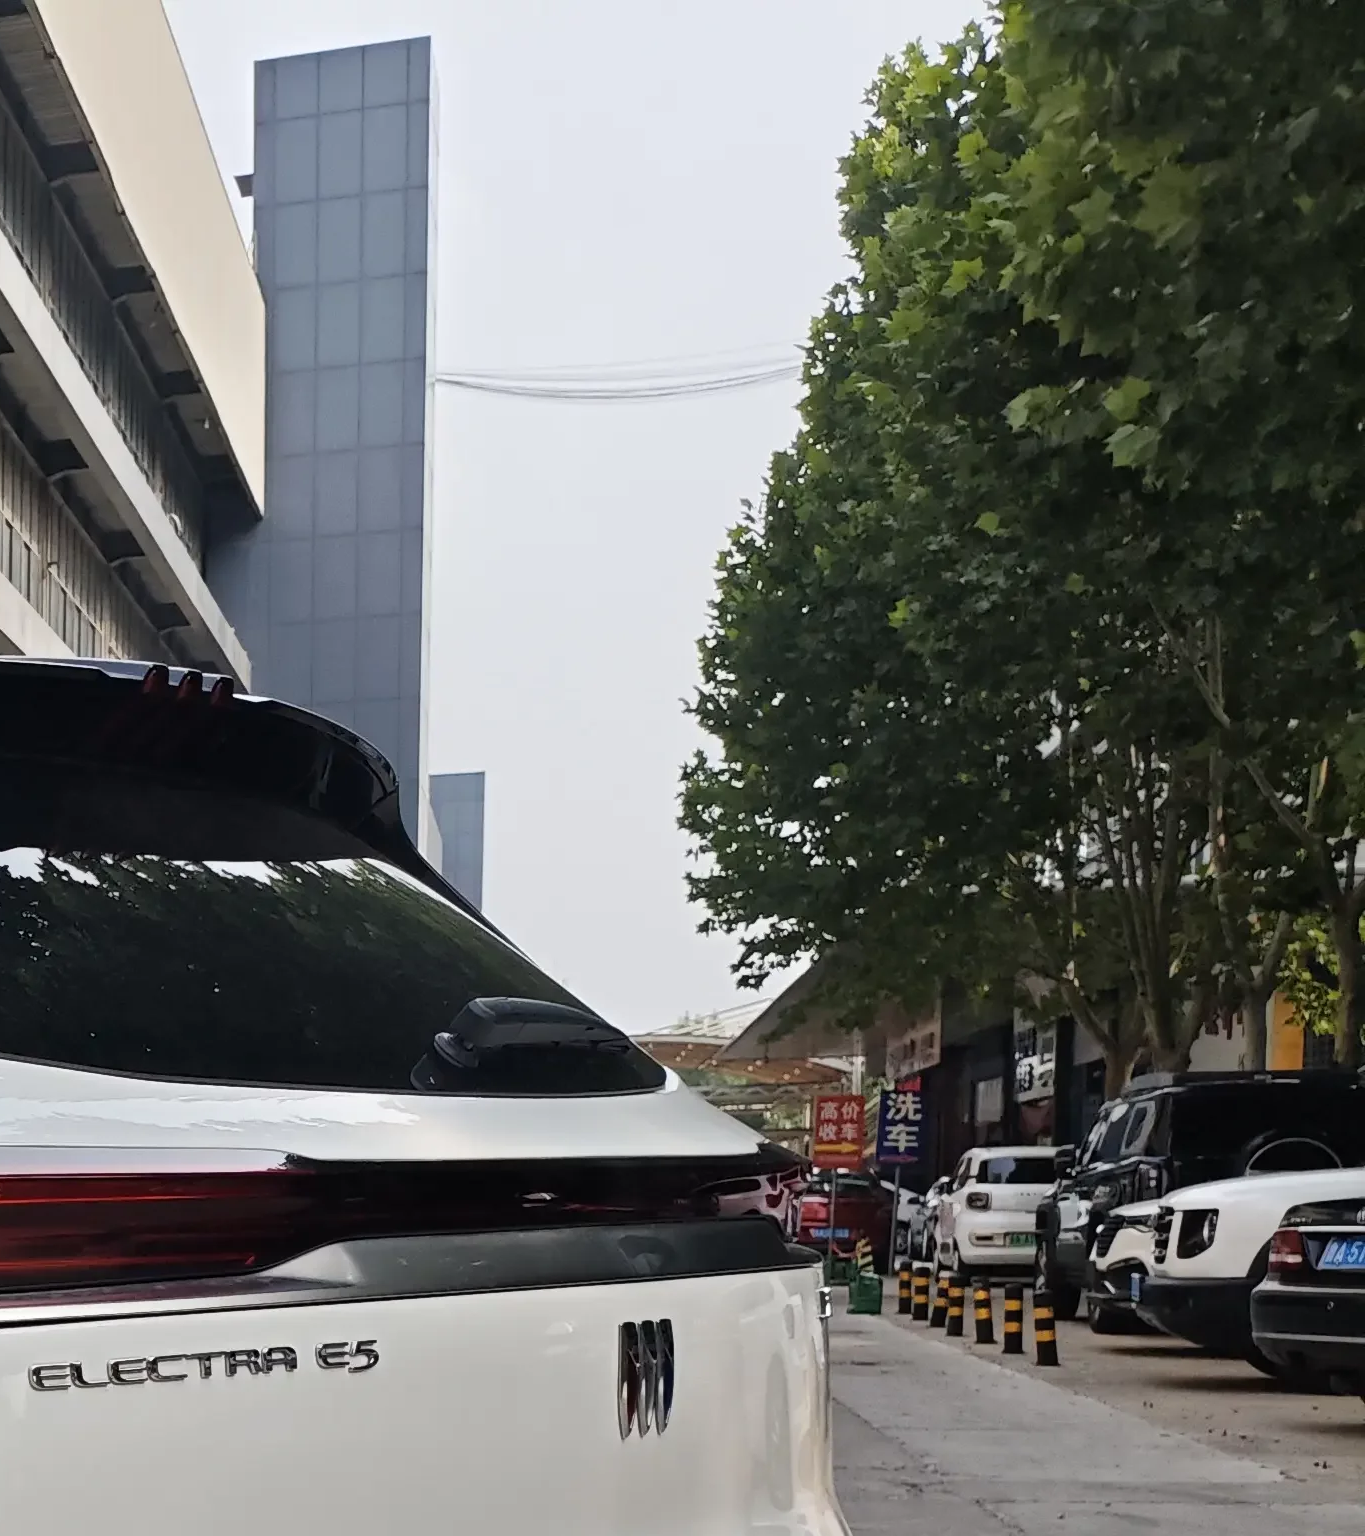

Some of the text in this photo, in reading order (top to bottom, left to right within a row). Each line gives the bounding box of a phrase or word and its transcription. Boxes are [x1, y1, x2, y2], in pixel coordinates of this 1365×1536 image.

[820, 1101, 860, 1121] 高价
[882, 1091, 922, 1152] 洗车
[819, 1123, 859, 1141] 收车
[28, 1339, 380, 1391] ELECTRA E5
